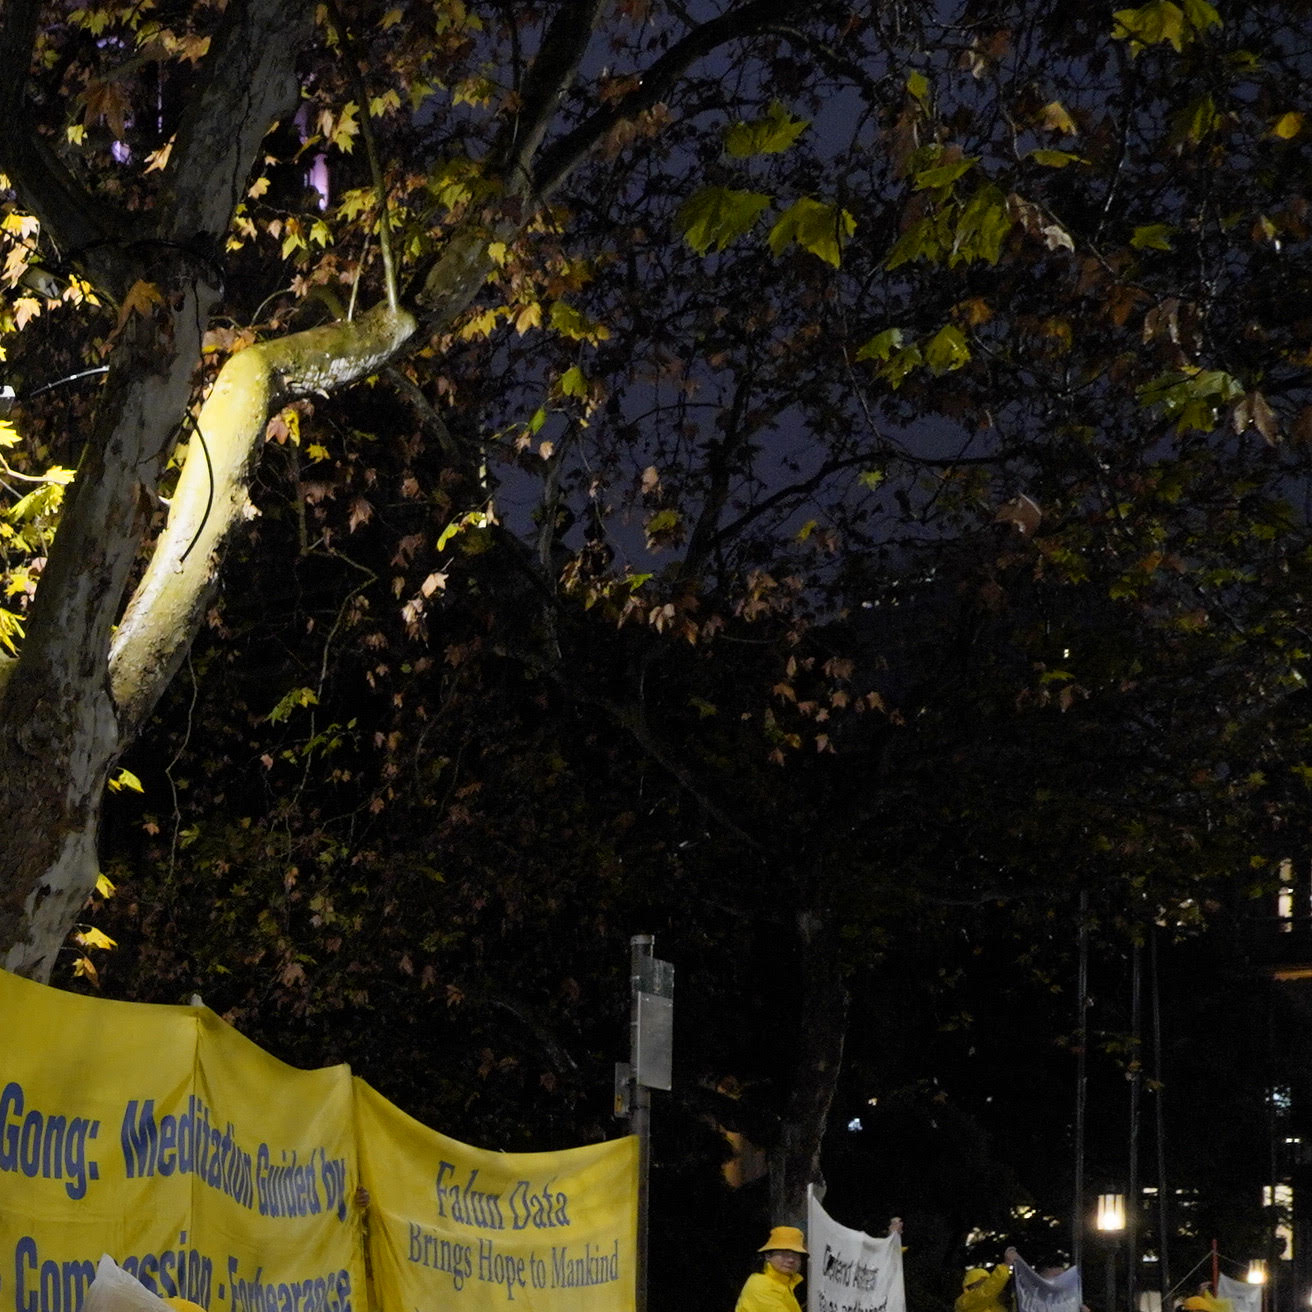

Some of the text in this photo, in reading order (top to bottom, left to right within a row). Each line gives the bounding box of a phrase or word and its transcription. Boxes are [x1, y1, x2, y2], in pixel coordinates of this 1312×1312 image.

[120, 1094, 254, 1211] Meditation
[256, 1142, 321, 1219] Guided
[320, 1146, 346, 1222] by
[436, 1160, 571, 1230] Falun Dafa
[408, 1221, 619, 1301] Brings Hope to Mankind
